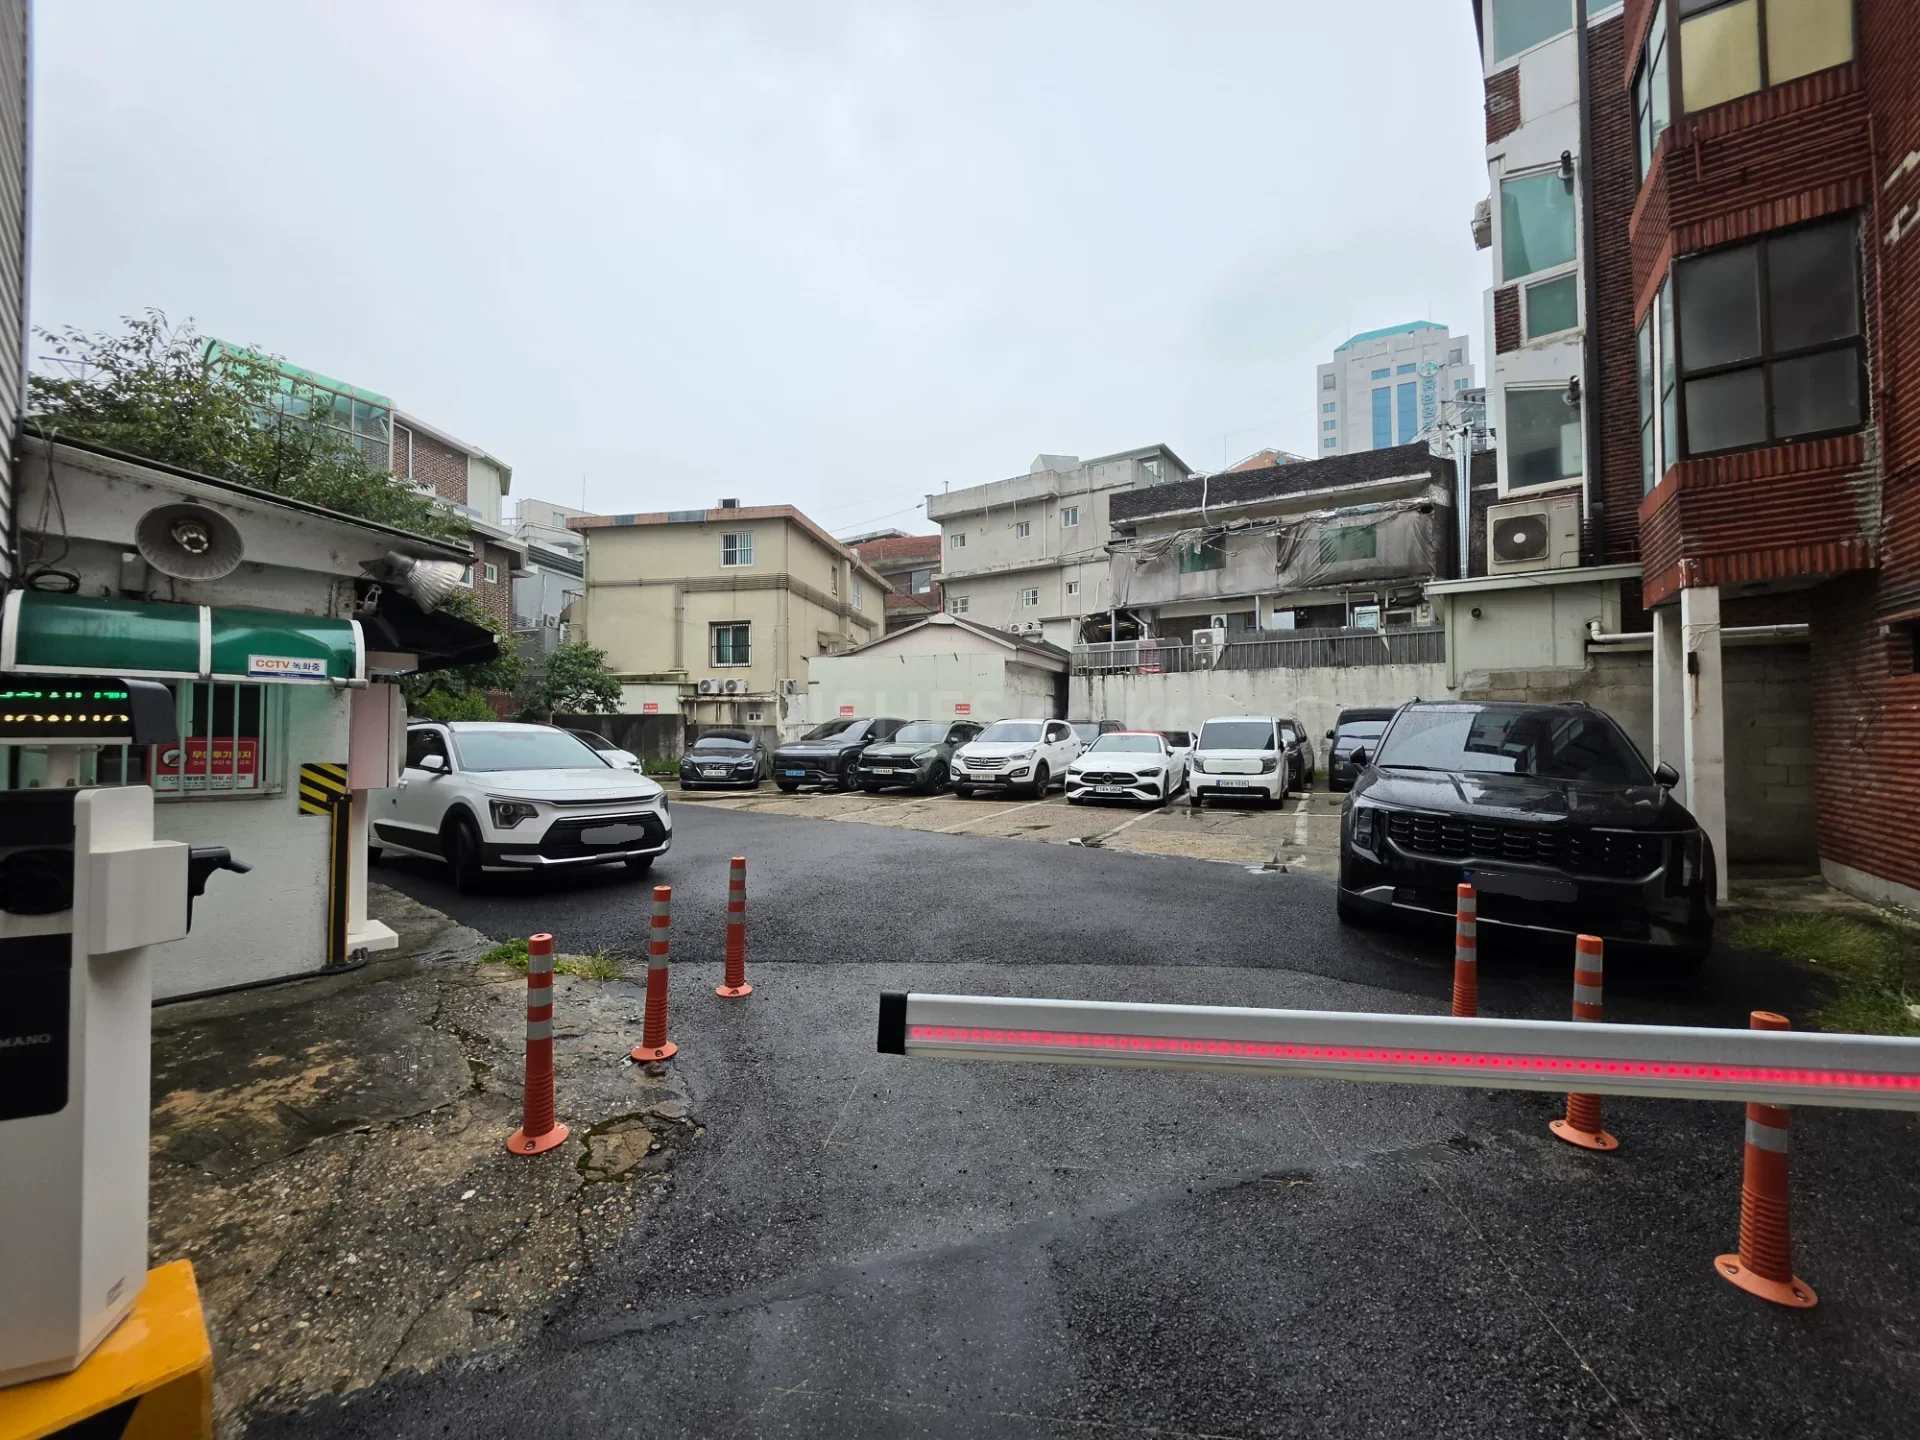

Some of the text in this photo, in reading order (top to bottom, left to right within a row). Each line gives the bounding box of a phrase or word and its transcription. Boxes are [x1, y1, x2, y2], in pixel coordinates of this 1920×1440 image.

[255, 659, 321, 672] CCTV 녹화중
[192, 750, 252, 759] 무투기지
